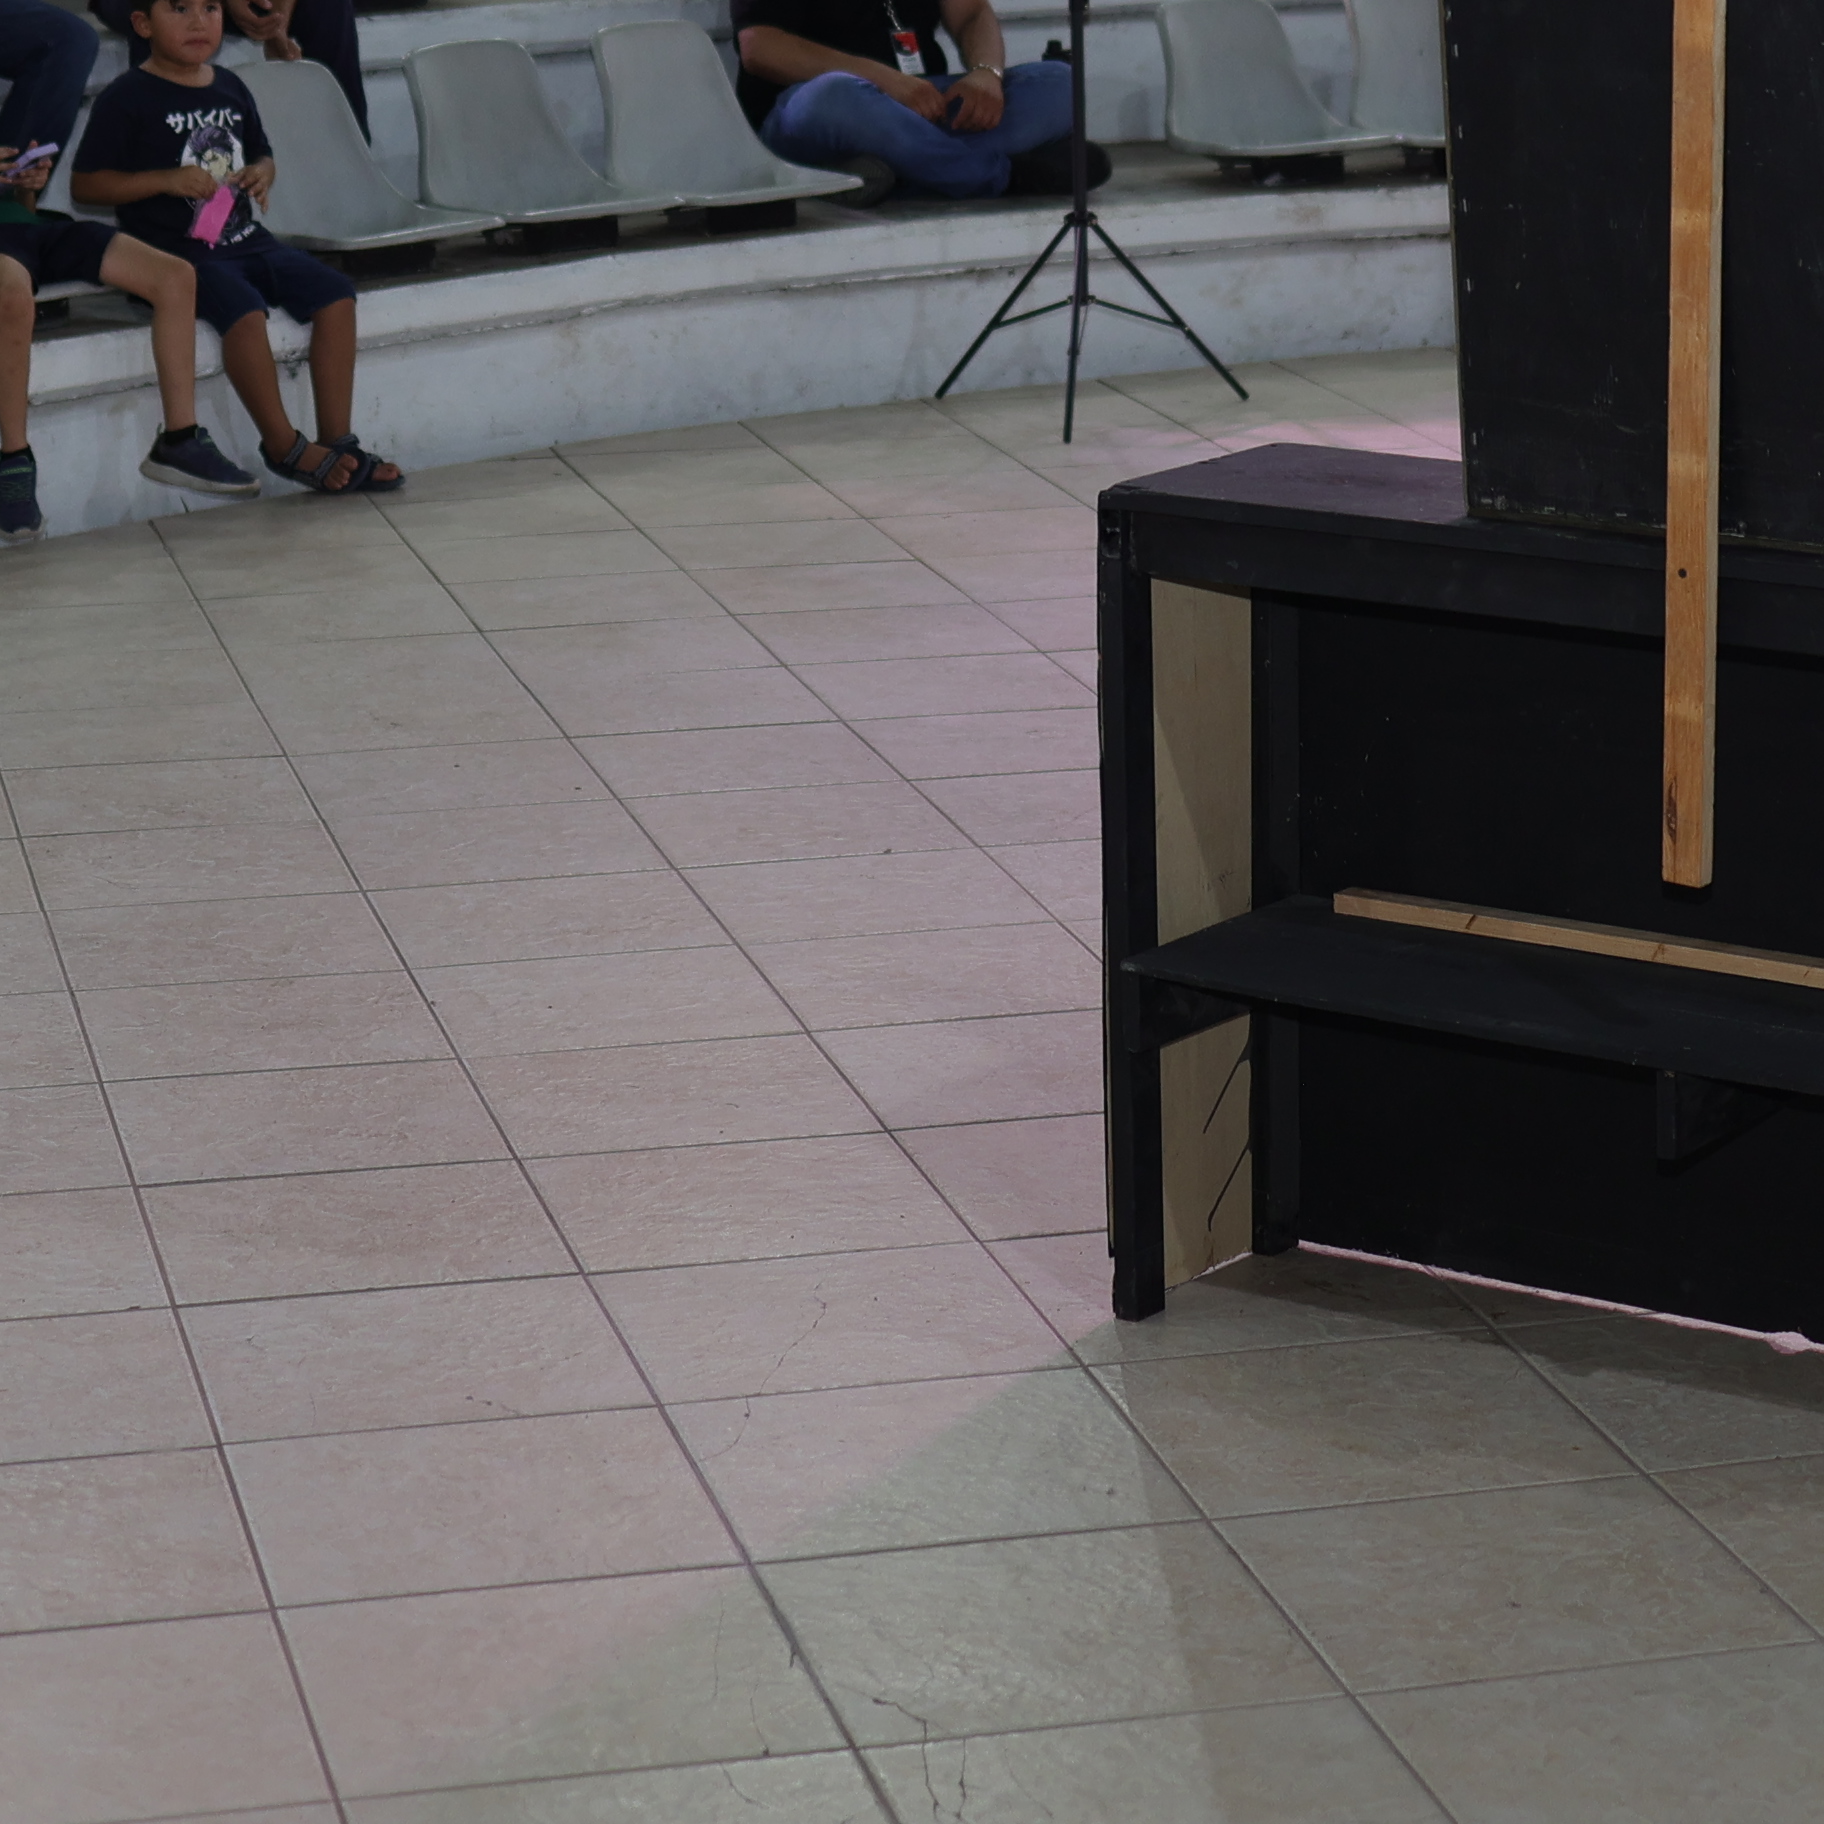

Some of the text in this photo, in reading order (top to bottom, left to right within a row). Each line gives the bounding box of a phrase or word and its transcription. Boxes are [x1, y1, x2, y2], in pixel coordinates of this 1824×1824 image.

[165, 107, 243, 135] サバイバー
